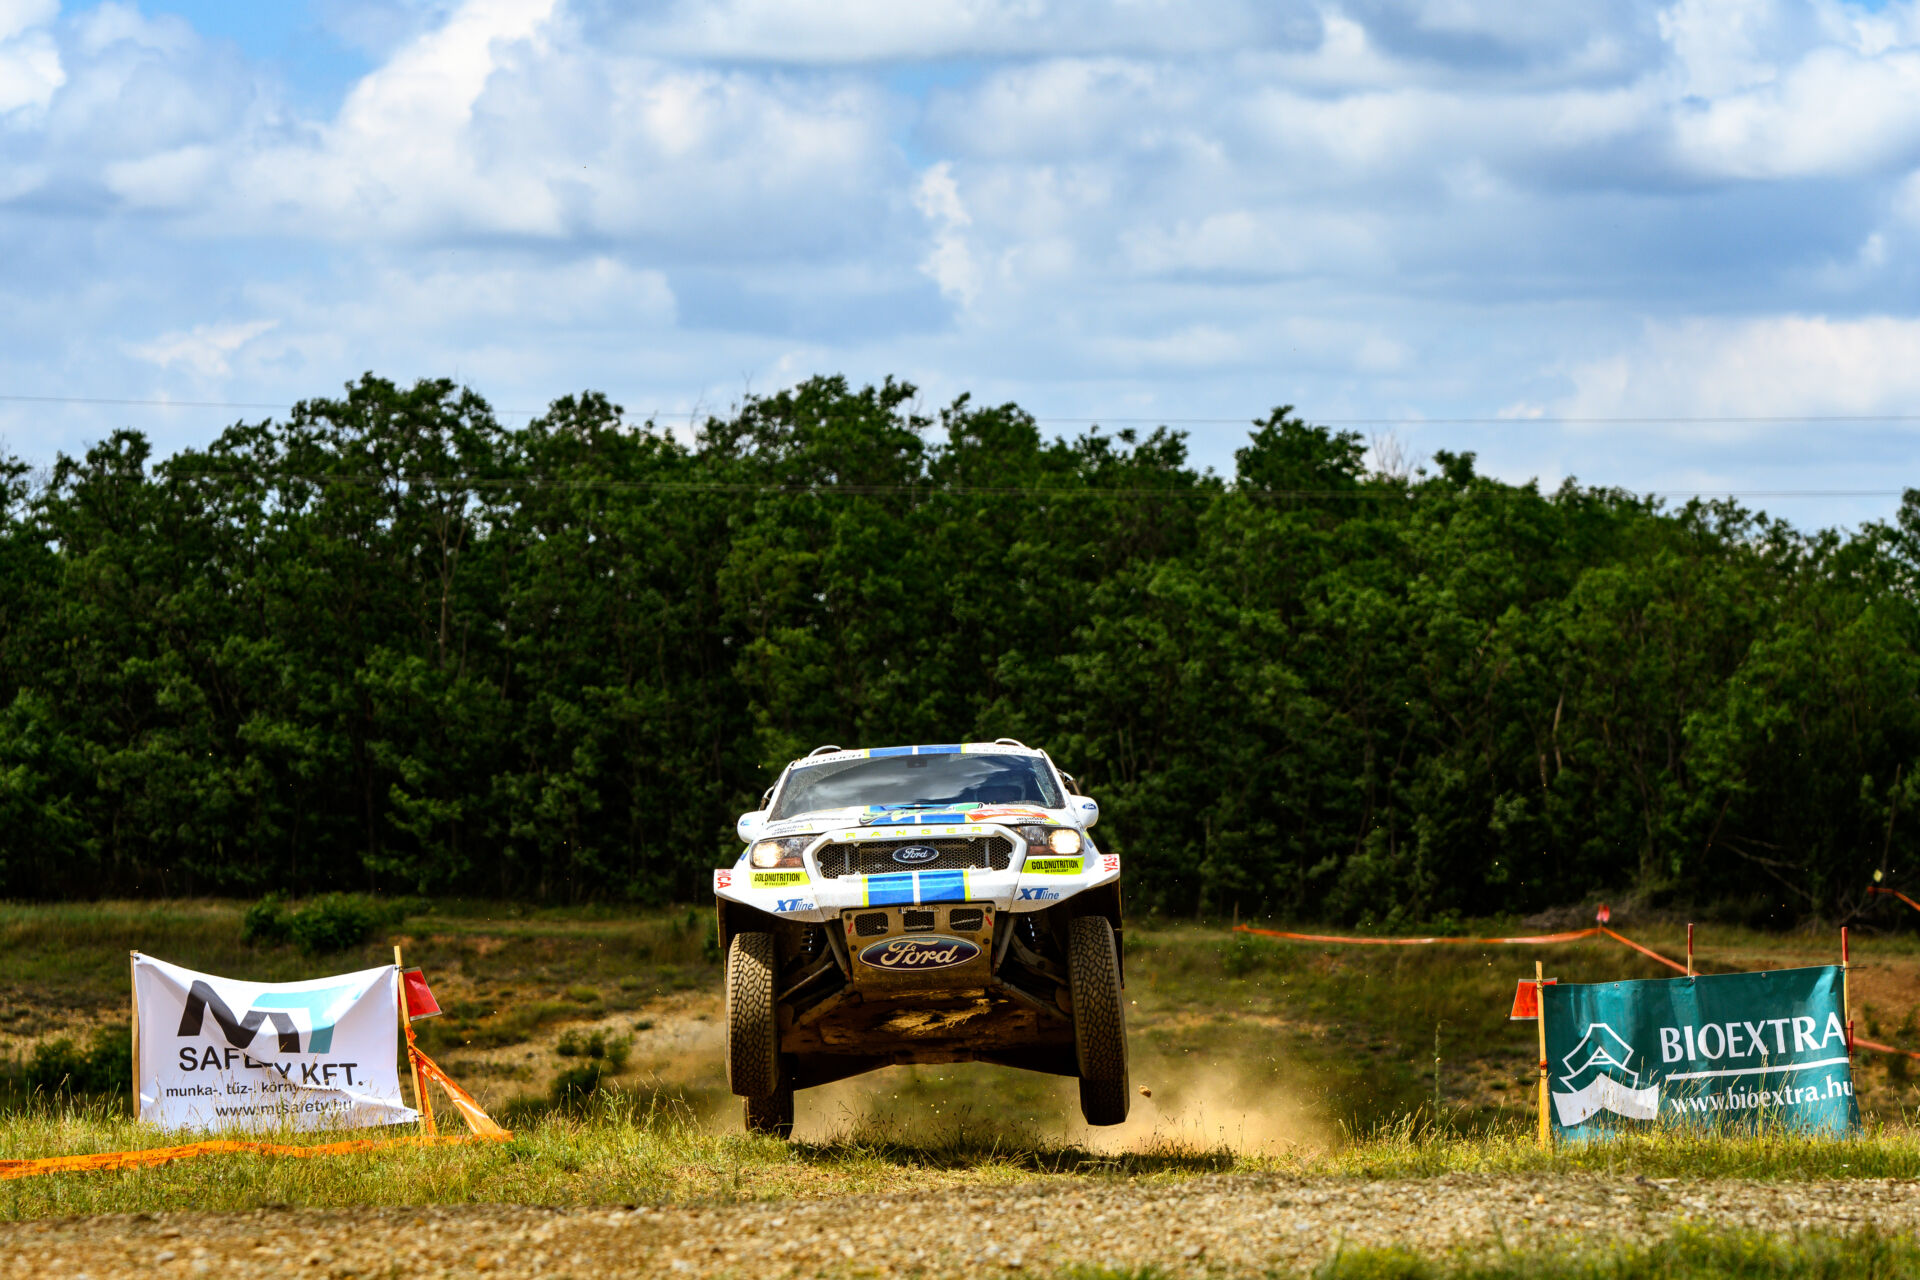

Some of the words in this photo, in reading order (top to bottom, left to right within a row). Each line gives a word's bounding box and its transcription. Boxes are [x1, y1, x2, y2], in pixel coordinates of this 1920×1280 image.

[901, 847, 929, 860] Ford
[1031, 859, 1079, 870] GOLDNUTRITION
[754, 872, 801, 882] GOLDNUTRITION
[1016, 887, 1060, 901] XTline
[773, 898, 814, 912] XTline
[880, 939, 959, 966] Ford
[1659, 1011, 1848, 1064] BIOEXTRA
[1670, 1074, 1854, 1114] www.bioextra.hu
